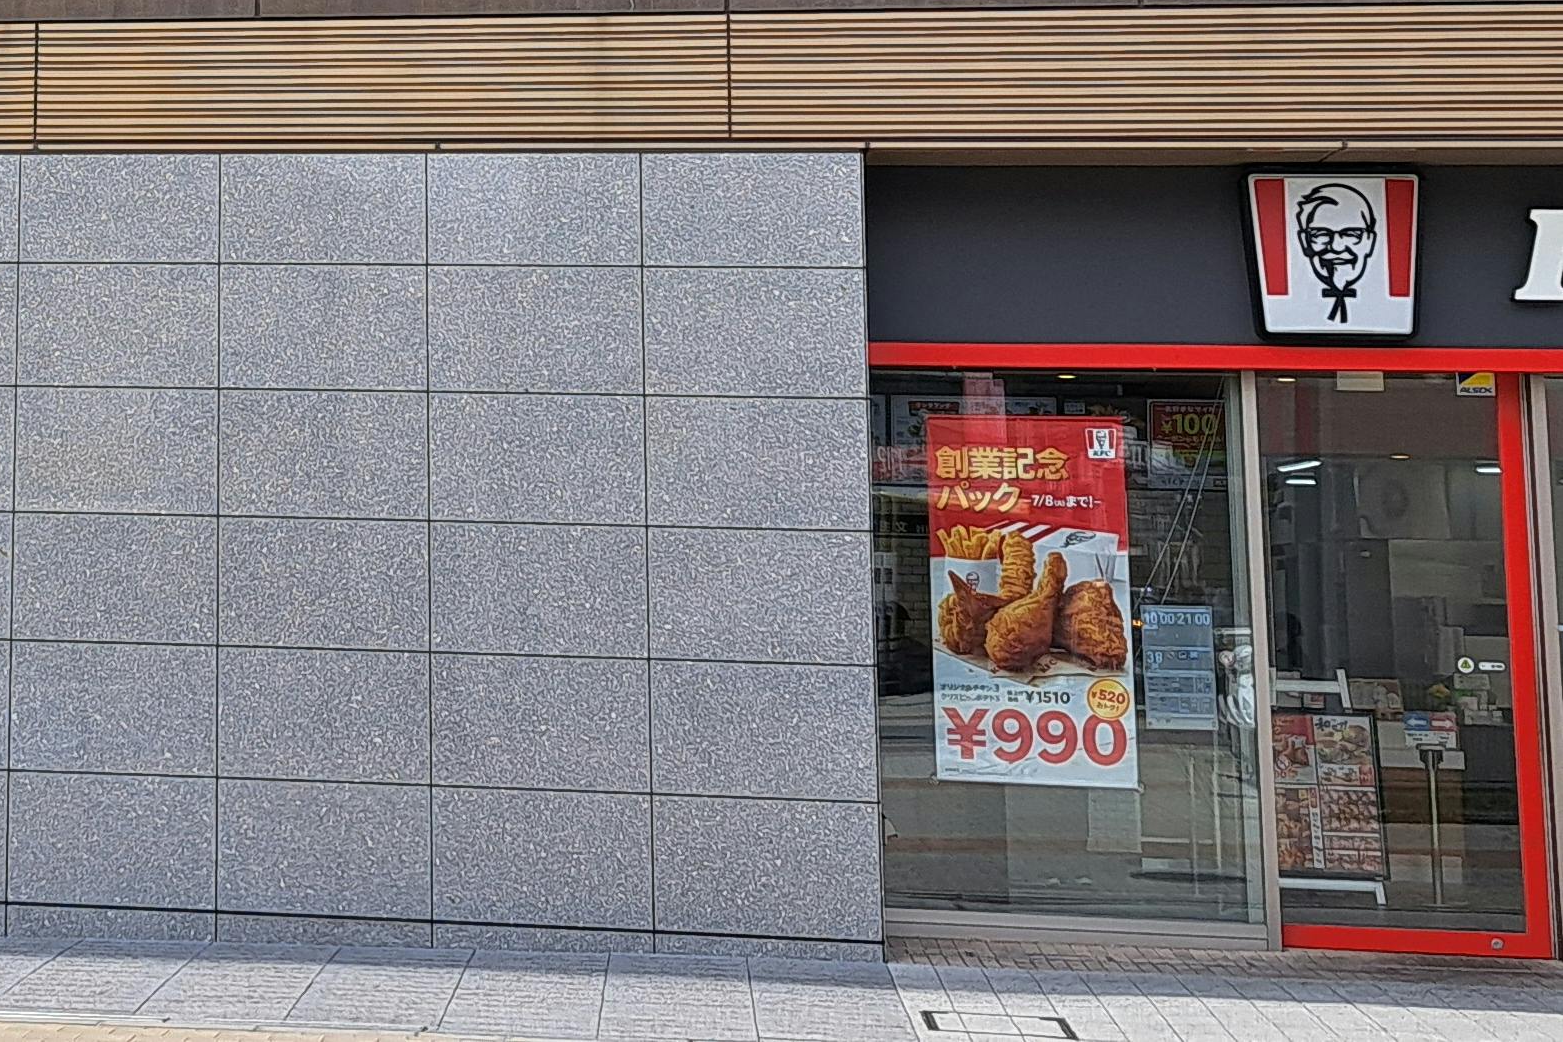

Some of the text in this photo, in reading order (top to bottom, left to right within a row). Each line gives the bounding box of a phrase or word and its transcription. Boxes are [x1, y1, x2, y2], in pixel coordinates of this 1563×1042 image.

[935, 446, 1069, 480] 創業記念
[937, 481, 1021, 512] パック
[941, 707, 1127, 767] ¥990
